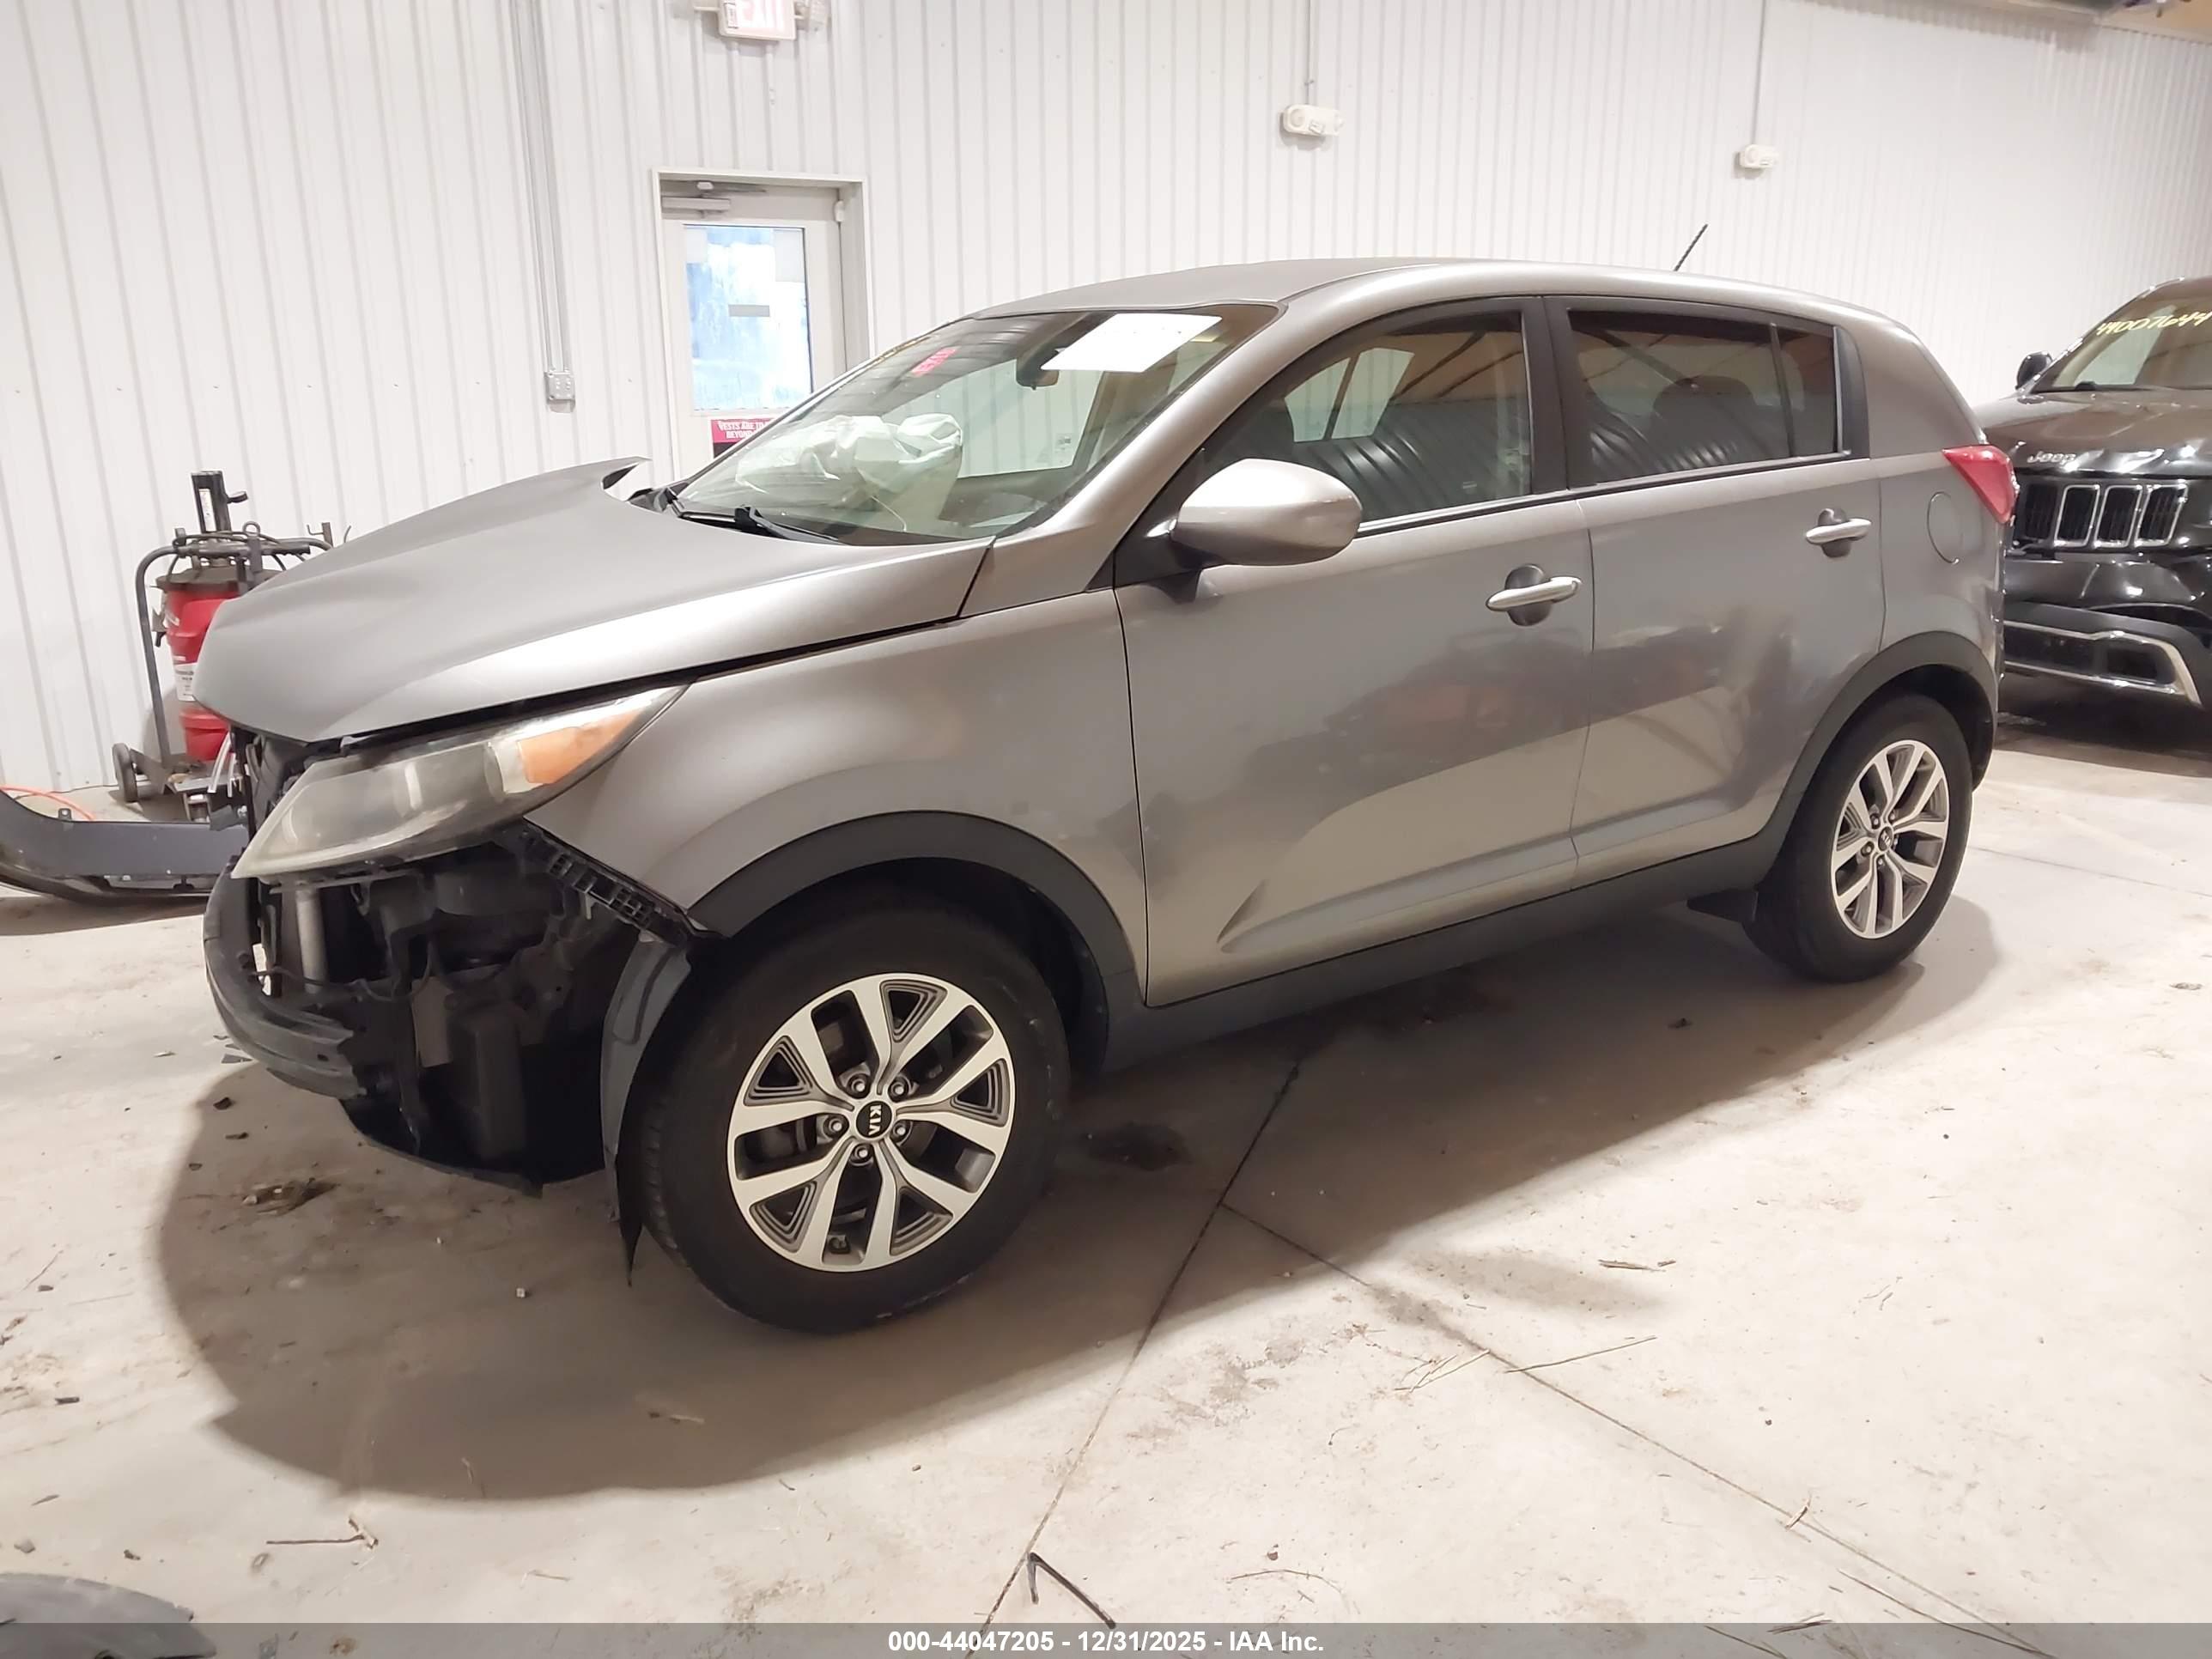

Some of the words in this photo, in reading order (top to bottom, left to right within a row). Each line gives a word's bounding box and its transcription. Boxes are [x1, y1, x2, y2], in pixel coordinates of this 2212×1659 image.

[718, 421, 740, 431] VESTS
[2027, 451, 2077, 465] Jeep
[868, 1104, 882, 1135] KIA
